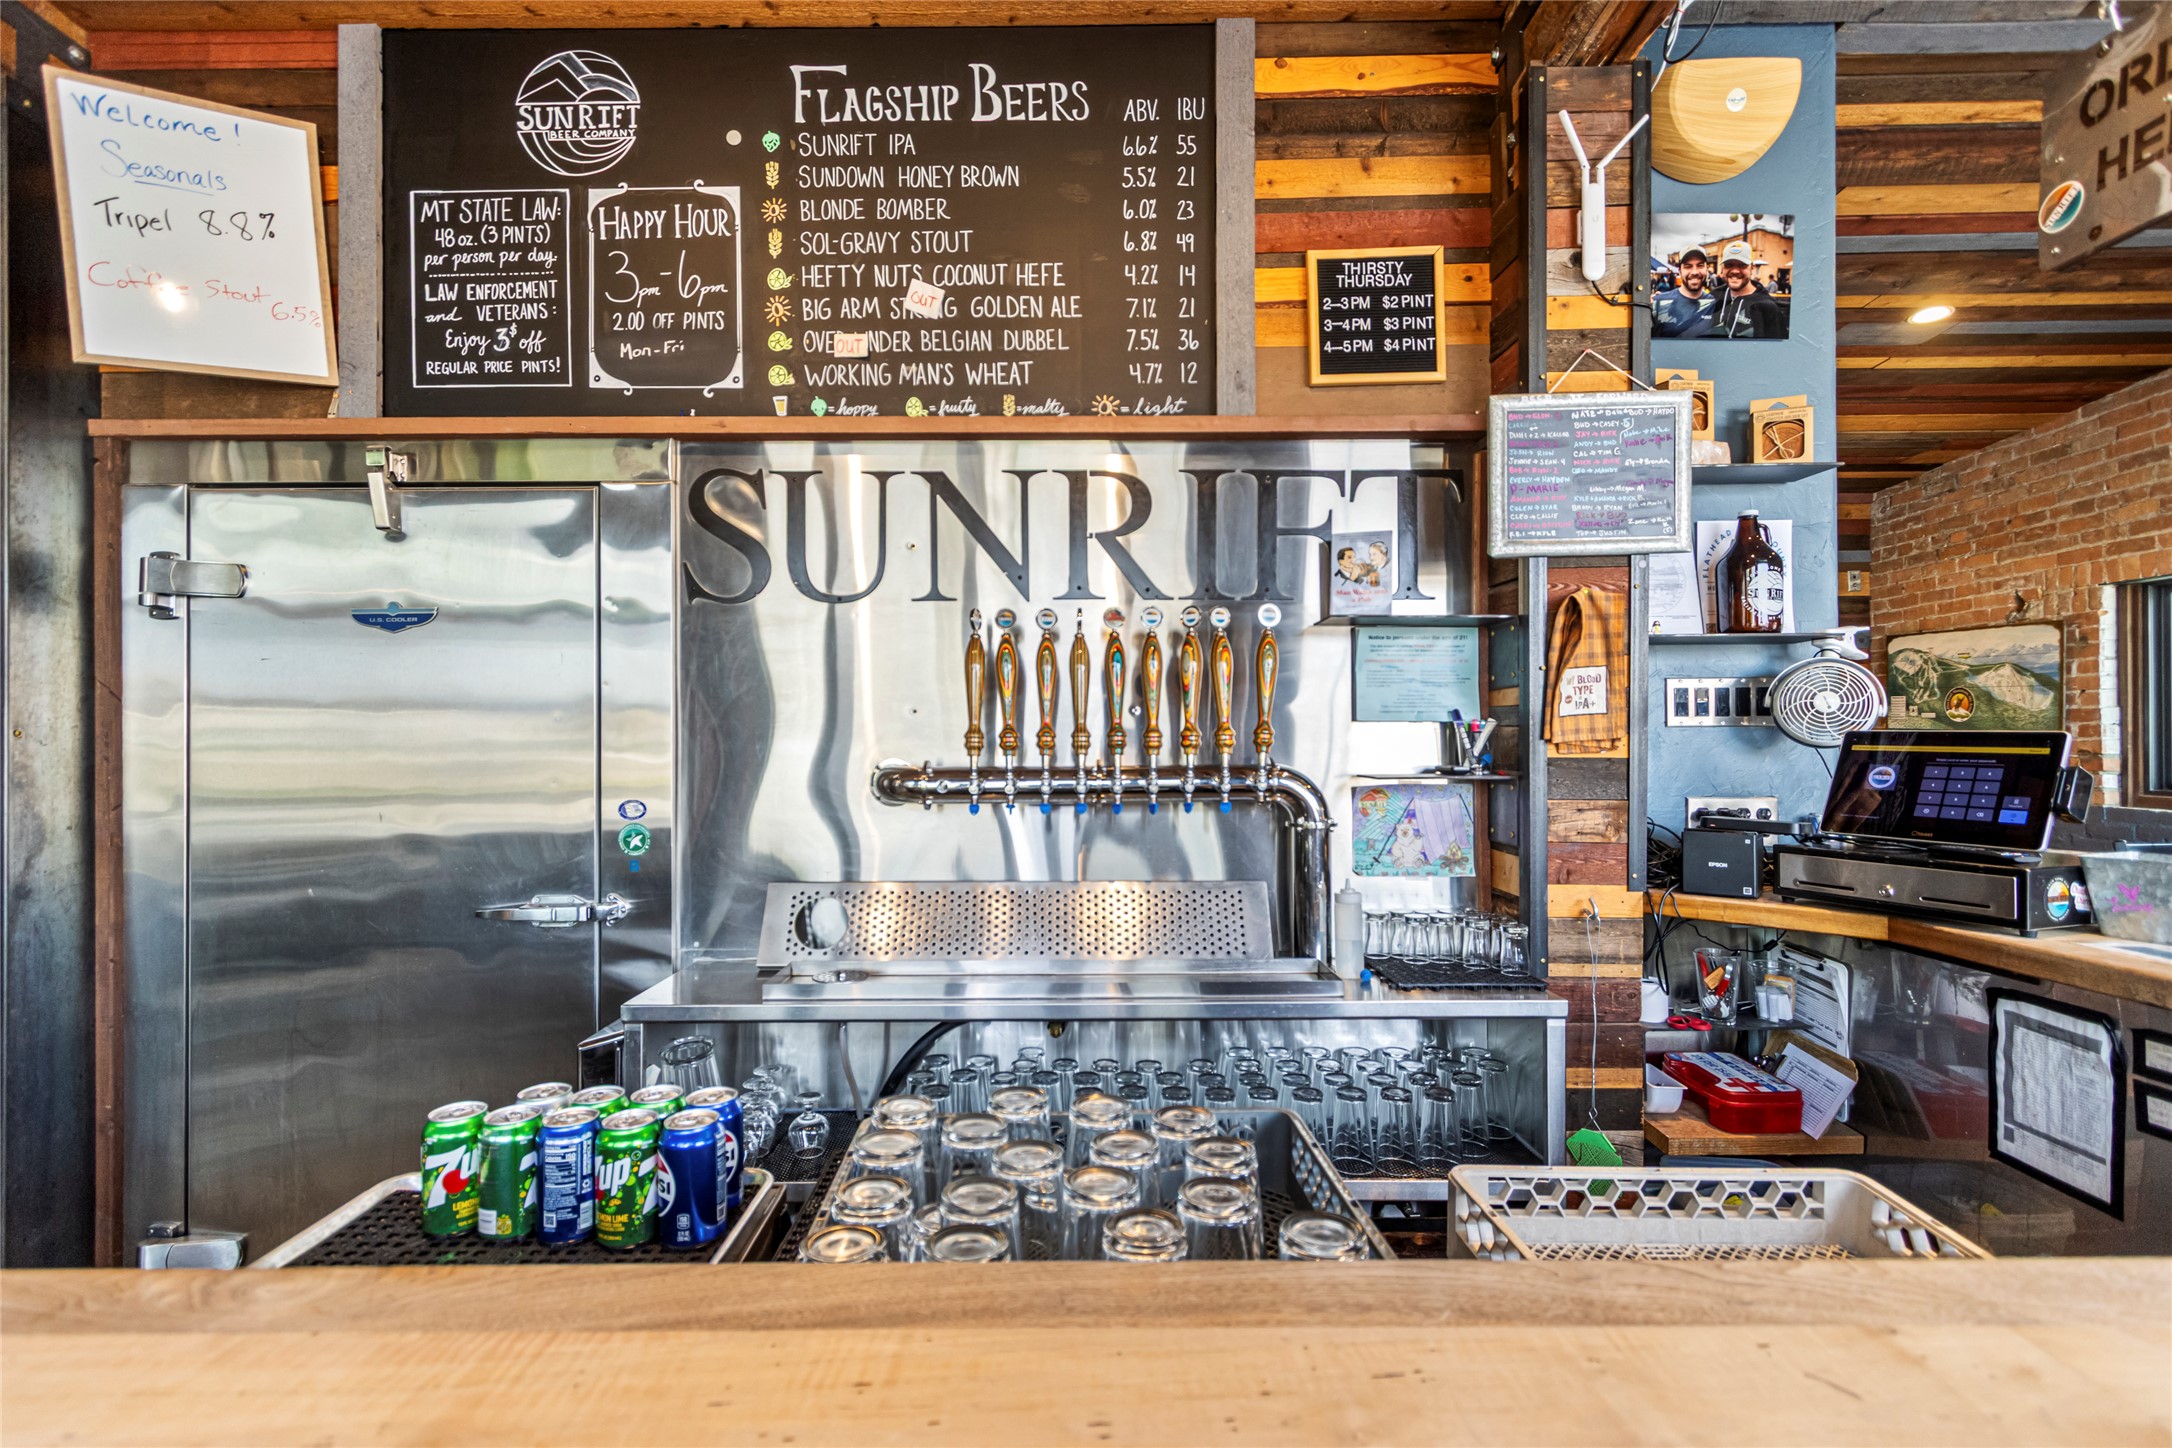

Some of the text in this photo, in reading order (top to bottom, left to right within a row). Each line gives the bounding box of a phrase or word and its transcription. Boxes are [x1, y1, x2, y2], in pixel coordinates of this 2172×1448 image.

[790, 64, 1089, 124] FLAGSHIP BEERS
[1178, 98, 1204, 120] IBU
[550, 129, 635, 139] BEER COMPANY
[799, 133, 1196, 156] SUNRIFT IPA 6.6% 55
[100, 139, 228, 192] Seasonals
[799, 165, 1194, 188] SUNDOWN HONEY BROWN 5.5% 21
[93, 196, 173, 238] Tripel
[421, 197, 561, 223] MT STATE LAW:
[800, 199, 1194, 221] BLONDE BOMBER 6.0% 23
[599, 204, 731, 240] HAPPY HOUR
[435, 228, 455, 247] 48
[503, 222, 550, 244] PINTS)
[801, 230, 1194, 255] SOL-GRAVY STOUT 6.8% 49
[424, 255, 448, 271] per
[452, 252, 495, 271] person
[499, 251, 522, 268] per
[1342, 261, 1403, 275] THIRSTY
[802, 263, 1195, 287] HEFTY NUTS COCONUT HEFE 4.2% 14
[1336, 273, 1412, 287] THURSDAY
[205, 279, 271, 304] Stout
[425, 280, 557, 301] LAW ENFORCEMENT
[911, 291, 937, 308] OUT
[1351, 296, 1370, 309] PM
[1383, 296, 1398, 309] $2
[1402, 294, 1433, 307] PINT
[271, 302, 322, 328] 6.5%
[425, 307, 462, 322] and
[803, 298, 831, 321] BIG
[841, 298, 880, 318] ARM
[971, 296, 1042, 318] GOLDEN
[1051, 296, 1082, 318] ALE
[1126, 298, 1156, 318] 7.1%
[1179, 298, 1194, 317] 21
[613, 311, 724, 330] 2.00 OFF PINTS
[1352, 318, 1370, 330] PM
[1384, 317, 1399, 331] $3
[1403, 316, 1434, 329] PINT
[446, 329, 491, 356] Enjoy
[519, 330, 546, 354] off
[836, 339, 863, 353] OUT
[921, 330, 992, 351] BELGIAN
[1004, 329, 1069, 351] DUBBEL
[1127, 329, 1159, 351] 7.5%
[1178, 329, 1199, 350] 36
[1353, 339, 1373, 352] PM
[1384, 339, 1399, 352] $4
[1403, 337, 1435, 350] PINT
[427, 357, 560, 375] REGULAR PRICE PINTS!
[804, 363, 891, 386] WORKING
[965, 361, 1033, 385] WHEAT
[1129, 363, 1162, 383] 4.7%
[1181, 362, 1197, 383] 12
[683, 468, 1464, 604] SUNRIFT
[1702, 529, 1732, 579] FLATHEAD
[1573, 685, 1594, 696] TYPE
[1577, 674, 1602, 685] BLOOD
